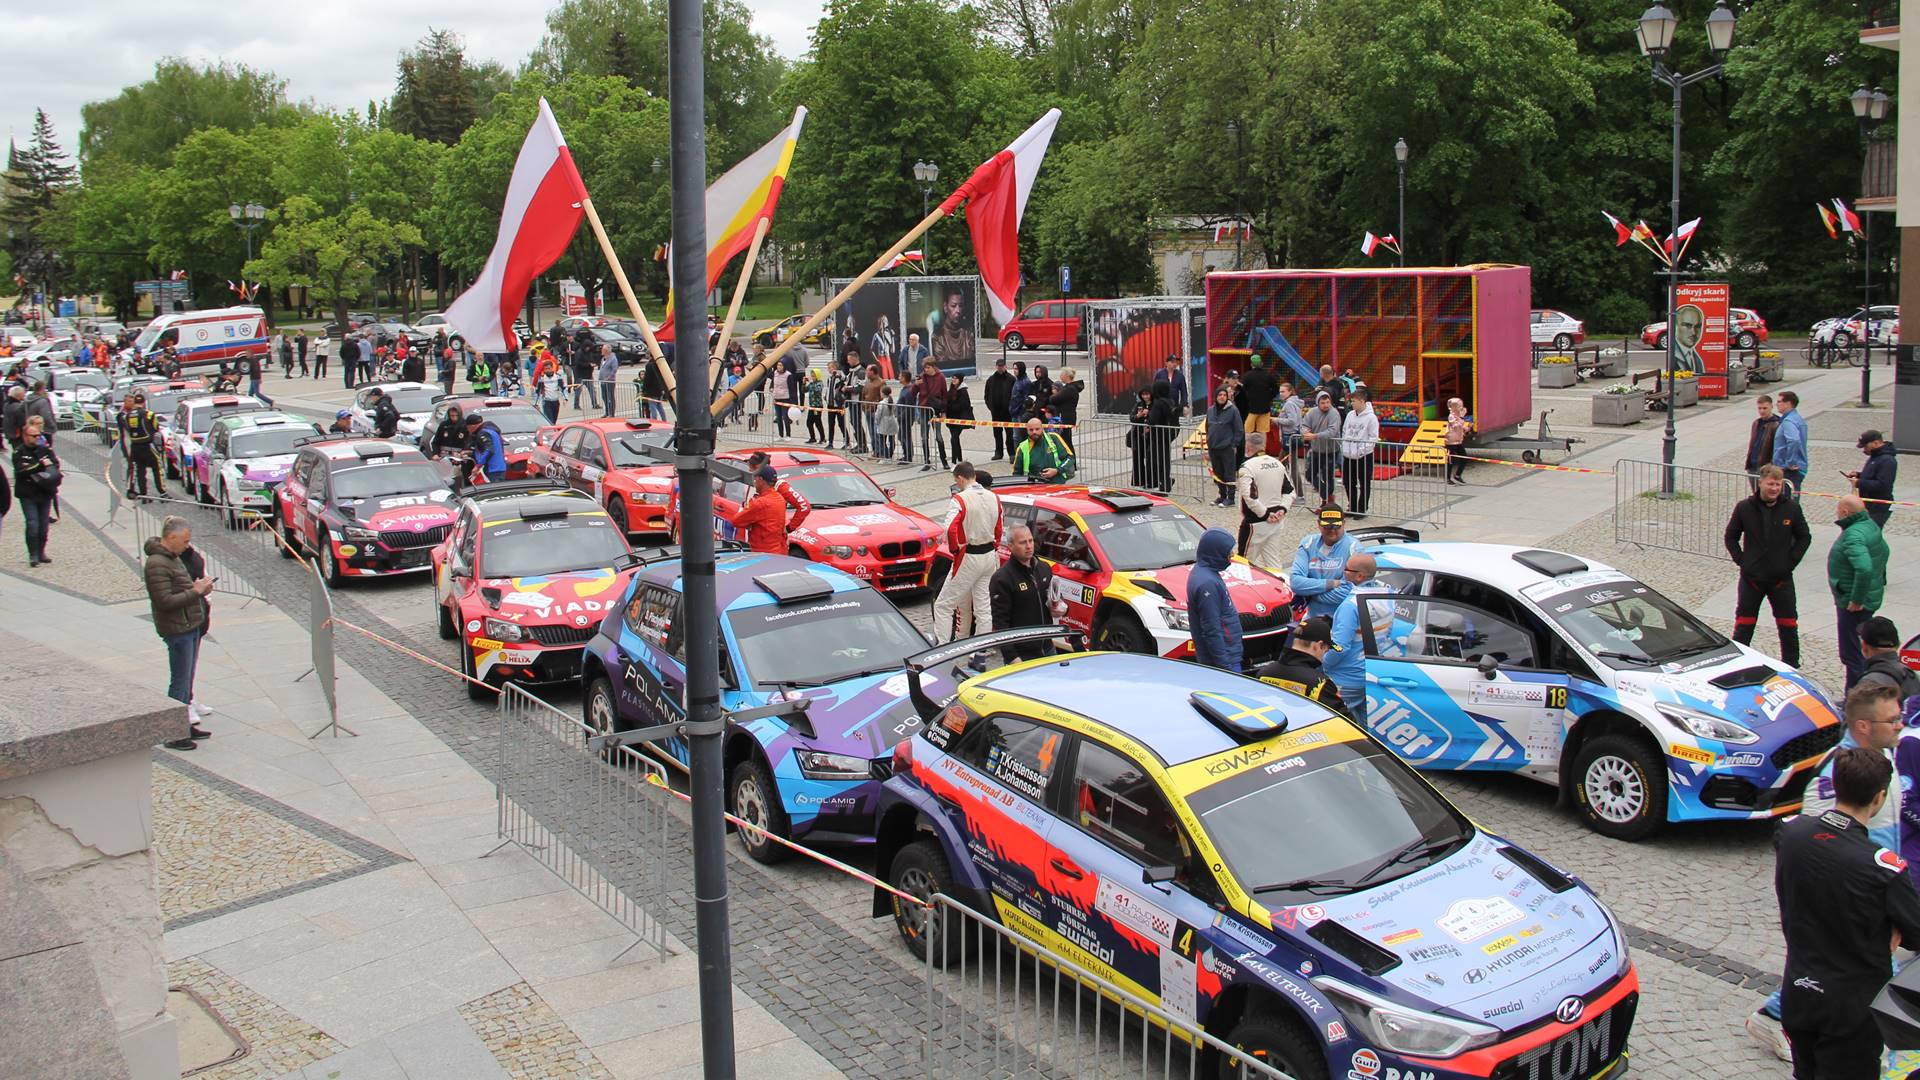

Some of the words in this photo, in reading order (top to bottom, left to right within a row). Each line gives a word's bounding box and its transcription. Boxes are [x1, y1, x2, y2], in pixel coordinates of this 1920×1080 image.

[398, 513, 449, 524] TAURON
[1084, 588, 1094, 604] 19
[1550, 687, 1568, 708] 18
[1037, 733, 1058, 770] 4
[1672, 745, 1711, 762] PIRELLI
[1263, 755, 1307, 775] racing
[941, 758, 957, 774] NV
[954, 765, 1000, 800] Entreprenad
[999, 792, 1016, 808] AB
[994, 764, 1041, 800] A.Johansson
[1114, 893, 1130, 907] 41
[1056, 921, 1115, 966] swedol
[1178, 928, 1193, 956] 4
[1224, 917, 1238, 930] Tom
[1237, 924, 1274, 951] Kristensson
[1486, 944, 1536, 973] HYUNDAI
[1587, 950, 1612, 975] swedol
[1265, 971, 1324, 1014] ELTEKNIK
[1483, 1000, 1524, 1019] swedol
[1355, 1056, 1378, 1069] Gulf
